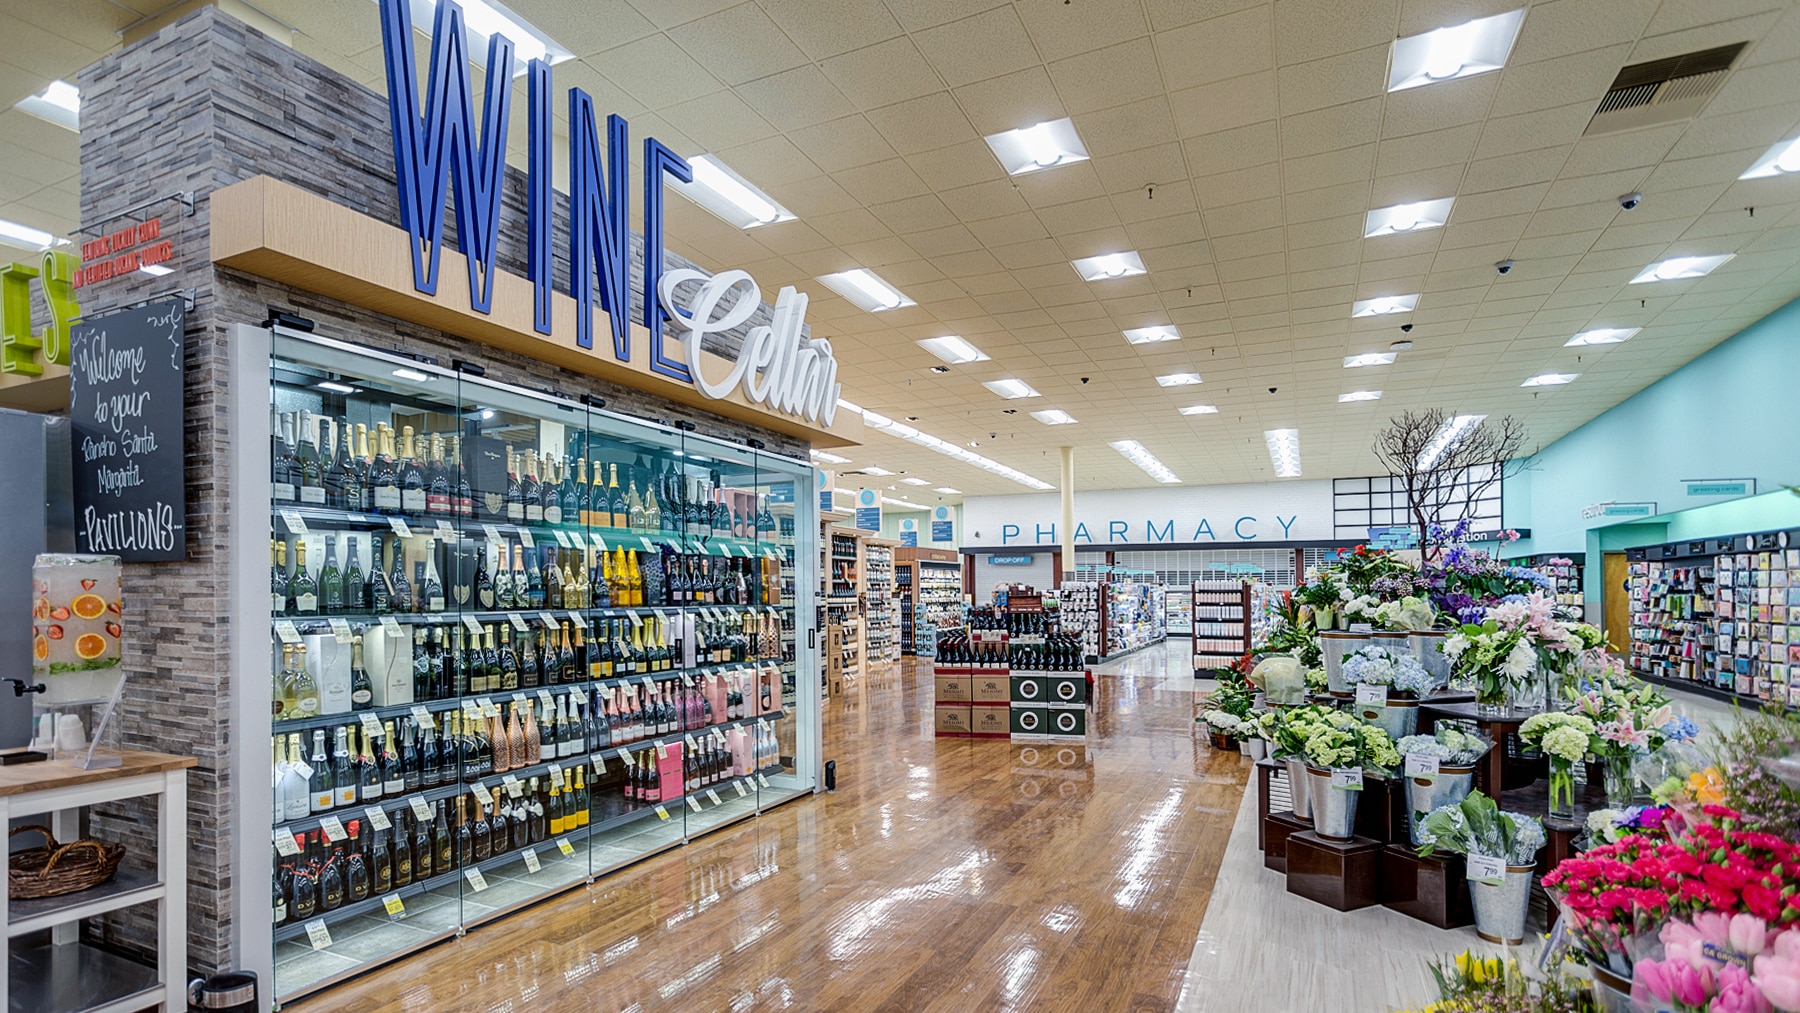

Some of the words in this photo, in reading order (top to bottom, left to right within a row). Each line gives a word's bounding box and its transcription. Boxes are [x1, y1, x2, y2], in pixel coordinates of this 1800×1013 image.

[380, 0, 693, 384] WINE
[79, 331, 146, 386] Welcome
[658, 269, 841, 428] Cellar
[95, 392, 108, 423] to
[111, 391, 150, 433] your
[82, 436, 116, 462] Rancho
[121, 425, 158, 457] Santa
[98, 460, 144, 497] Margarita
[1002, 514, 1297, 545] PHARMACY
[1703, 947, 1715, 957] CA
[1716, 951, 1746, 967] GROWN
